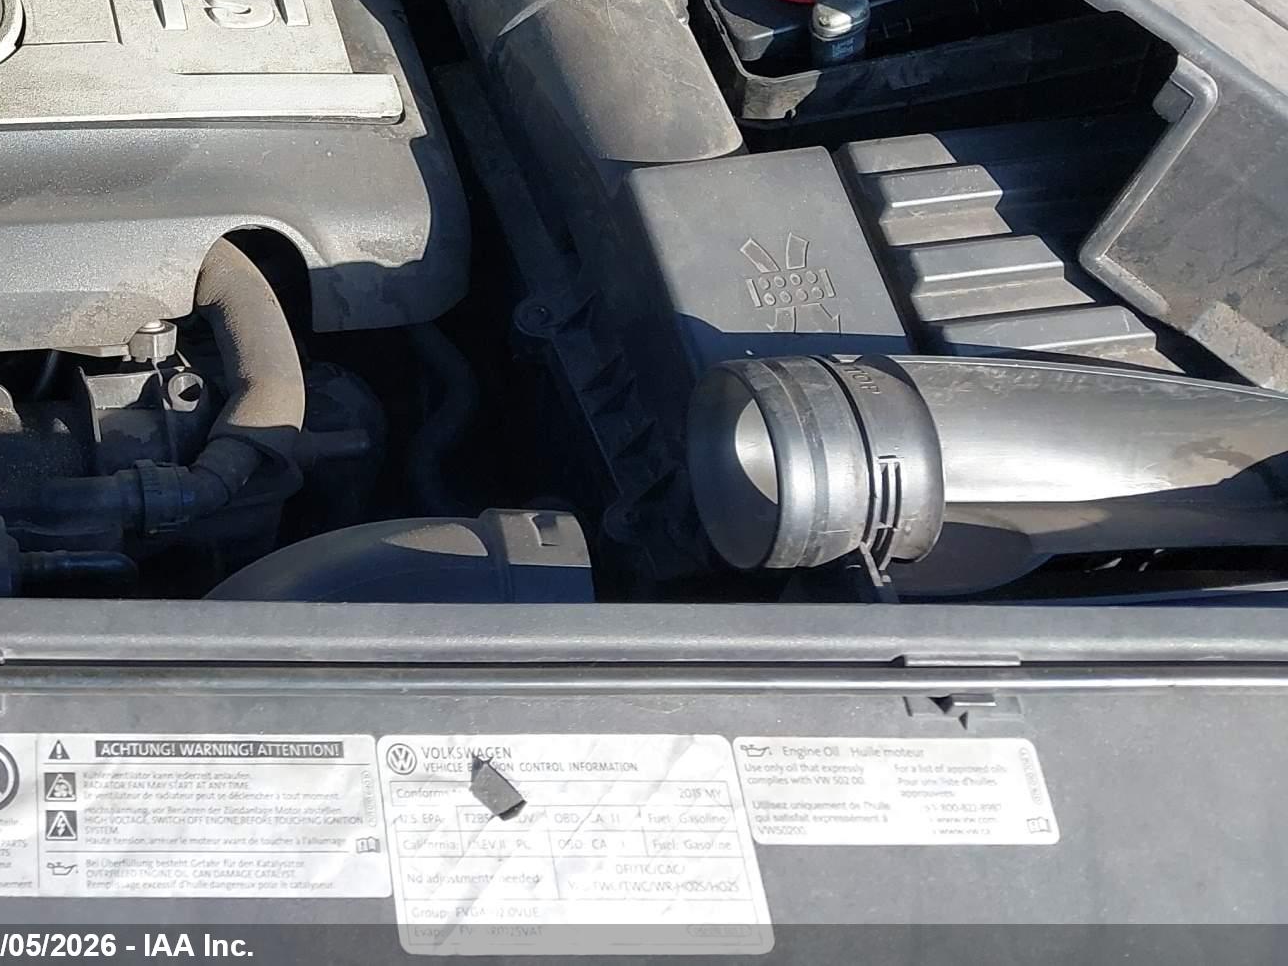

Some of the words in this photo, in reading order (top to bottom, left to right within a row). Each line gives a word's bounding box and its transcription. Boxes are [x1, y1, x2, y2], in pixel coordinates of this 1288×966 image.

[844, 367, 882, 395] TOP
[101, 743, 176, 756] ACHTUNG!
[179, 743, 253, 756] WARNING!
[258, 743, 339, 756] ATTENTION!
[420, 746, 512, 759] VOLKSWAGEN
[782, 746, 821, 760] Engine
[823, 746, 840, 757] Oil
[850, 747, 881, 758] Huile
[883, 746, 925, 758] moteur
[423, 763, 464, 772] VEHICLE
[520, 763, 564, 772] CONTROL
[569, 763, 639, 772] INFORMATION
[744, 764, 762, 772] Use
[764, 764, 783, 775] only
[785, 763, 799, 772] oil
[800, 763, 819, 772] that
[821, 764, 864, 775] expressly
[746, 776, 789, 787] complies
[790, 776, 813, 786] with
[814, 777, 831, 786] VW
[832, 776, 849, 786] 502
